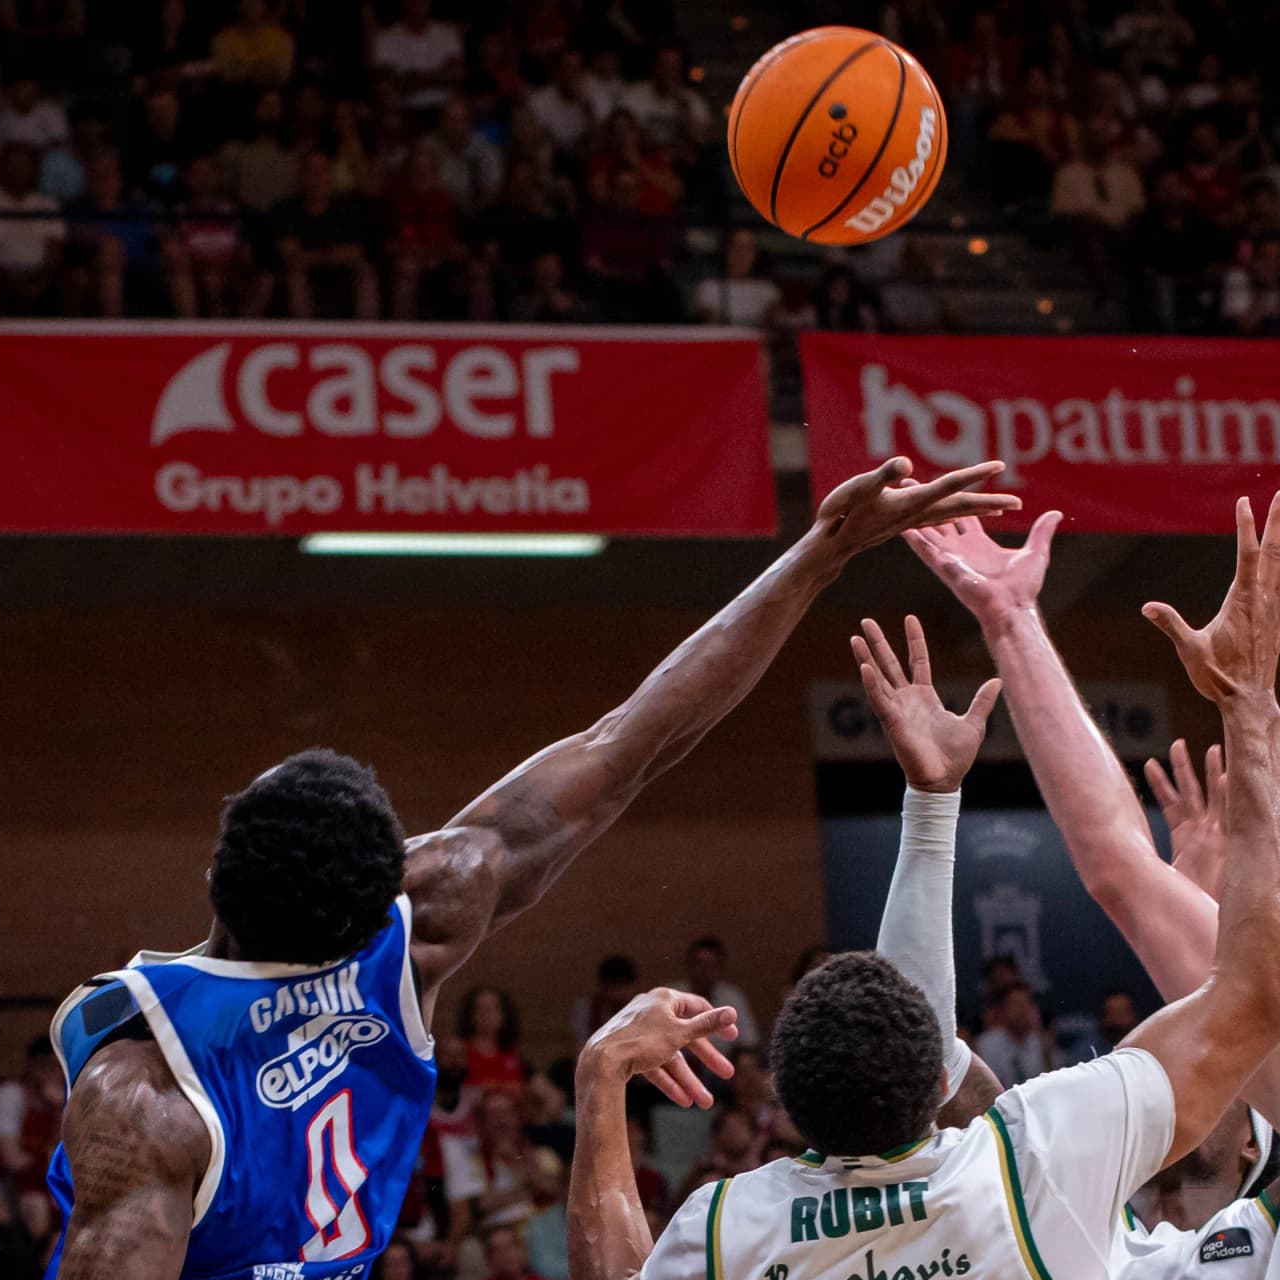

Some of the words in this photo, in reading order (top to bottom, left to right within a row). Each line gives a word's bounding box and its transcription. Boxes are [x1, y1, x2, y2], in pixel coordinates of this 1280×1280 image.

[818, 122, 858, 180] acb
[237, 344, 579, 438] caser
[155, 463, 341, 523] Grupo
[357, 464, 589, 514] Helvetia
[791, 1182, 928, 1243] RUBIT
[1203, 1245, 1251, 1261] endesa
